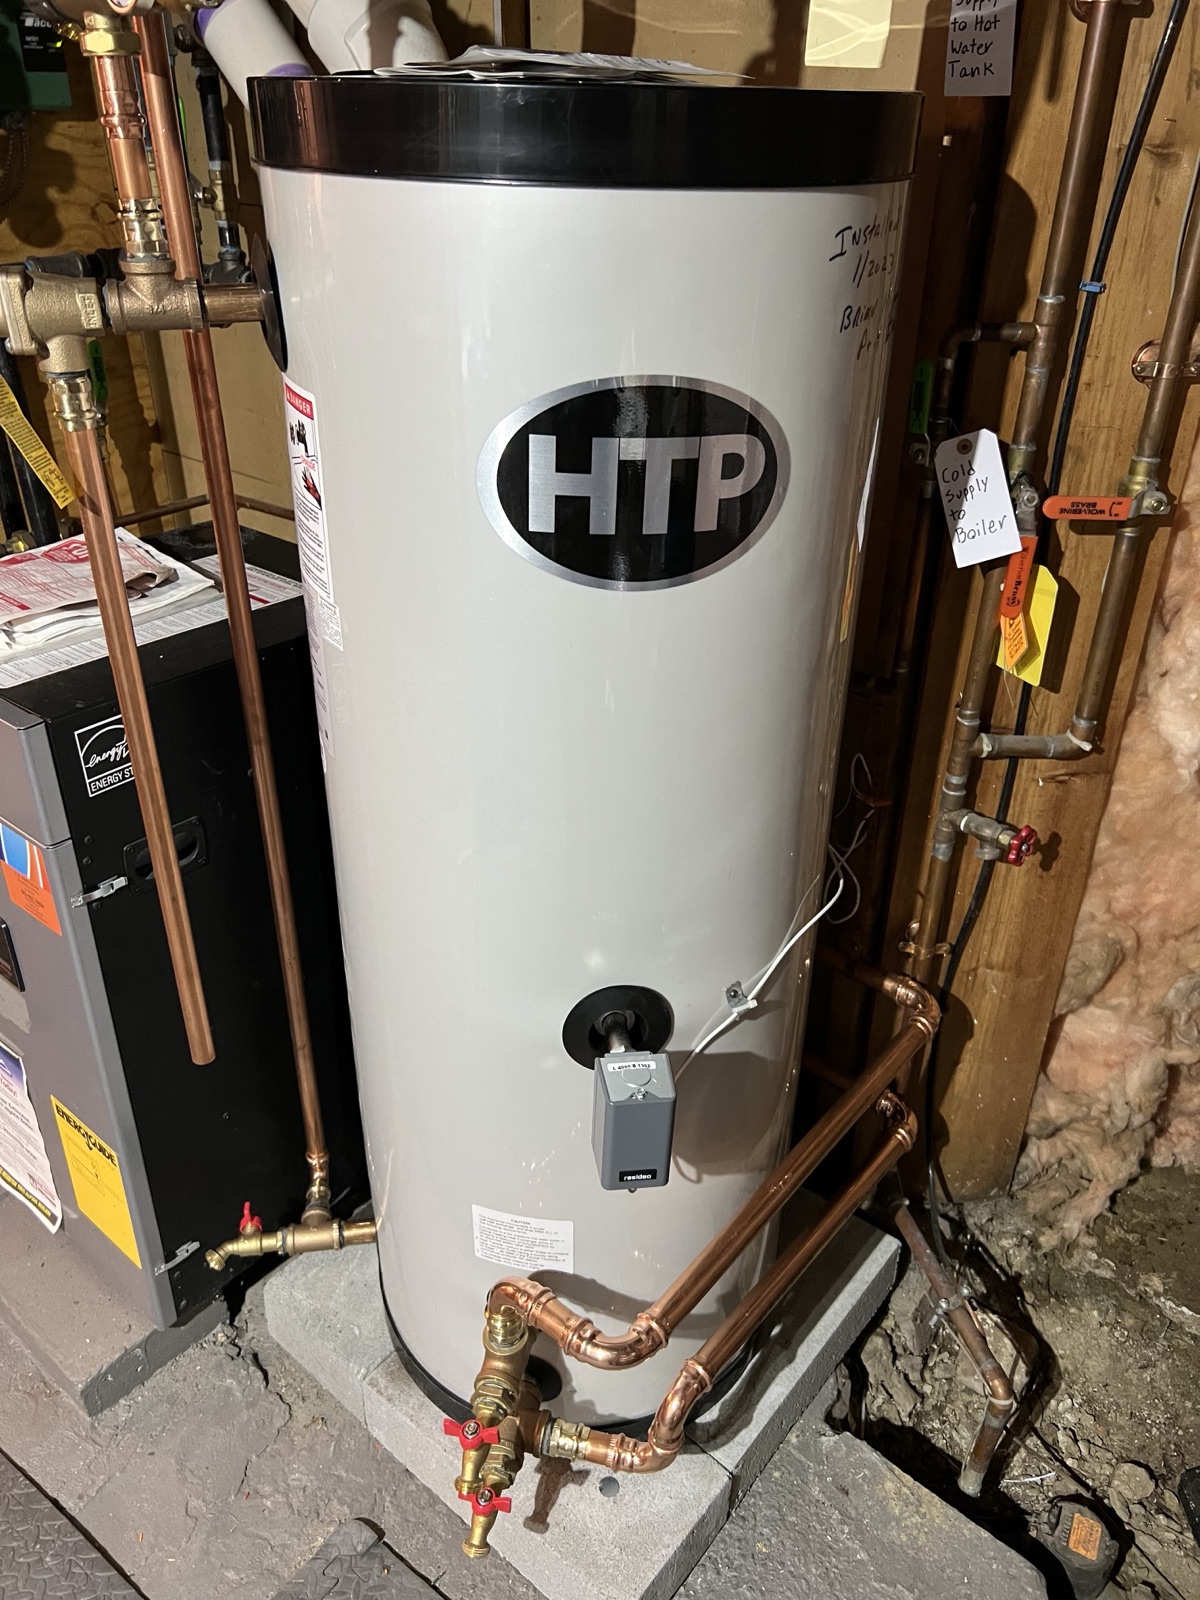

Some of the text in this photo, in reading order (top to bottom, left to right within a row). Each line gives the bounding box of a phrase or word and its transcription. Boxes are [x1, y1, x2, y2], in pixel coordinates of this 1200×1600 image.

[951, 14, 1001, 32] to Hot
[950, 38, 993, 56] Water
[948, 60, 994, 78] Tank
[852, 249, 895, 288] 1/2023
[942, 460, 976, 484] Cold
[528, 433, 766, 535] HTP
[949, 508, 966, 521] to
[1058, 507, 1106, 515] WOLVERINE
[954, 515, 1007, 544] Boiler
[90, 770, 123, 792] ENERGY
[623, 1173, 652, 1181] resideo
